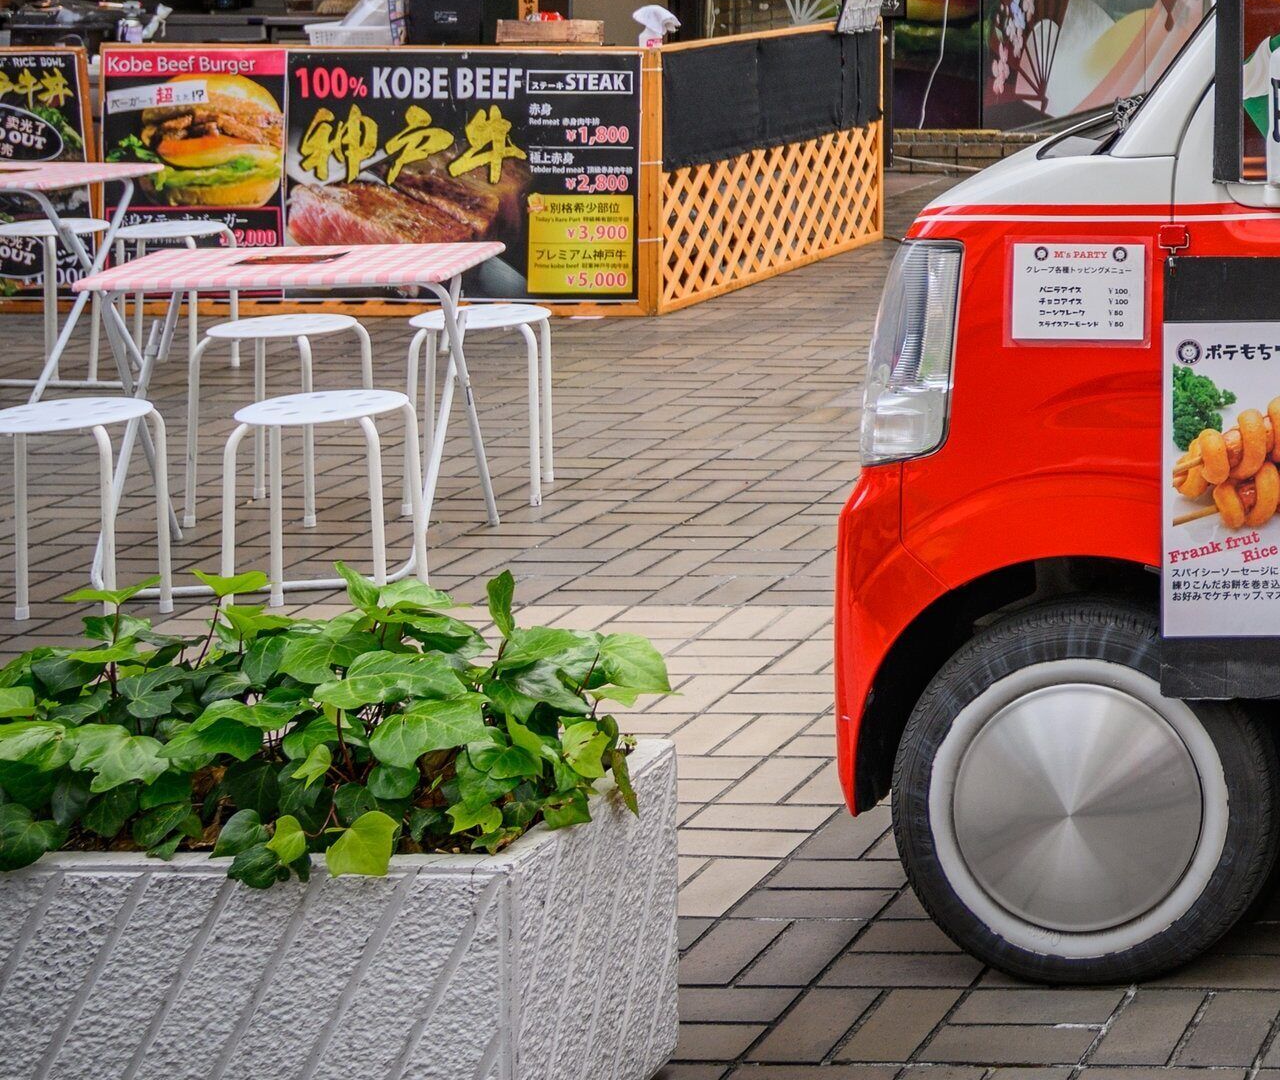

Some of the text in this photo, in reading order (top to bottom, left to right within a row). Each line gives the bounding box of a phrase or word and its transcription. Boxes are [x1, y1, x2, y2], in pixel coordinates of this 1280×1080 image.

[107, 55, 256, 75] Kobe Beef Burger
[295, 66, 524, 100] 100% KOBE BEEF
[529, 102, 553, 117] 赤身
[300, 103, 528, 186] 神戸牛
[566, 125, 630, 146] ¥1,800
[565, 174, 629, 194] ¥2,800
[567, 225, 628, 242] ¥3,900
[535, 249, 627, 261] プレミアム神戸牛
[567, 272, 628, 289] ¥5,000
[1168, 530, 1261, 564] Frank frut
[1241, 545, 1278, 564] Rice
